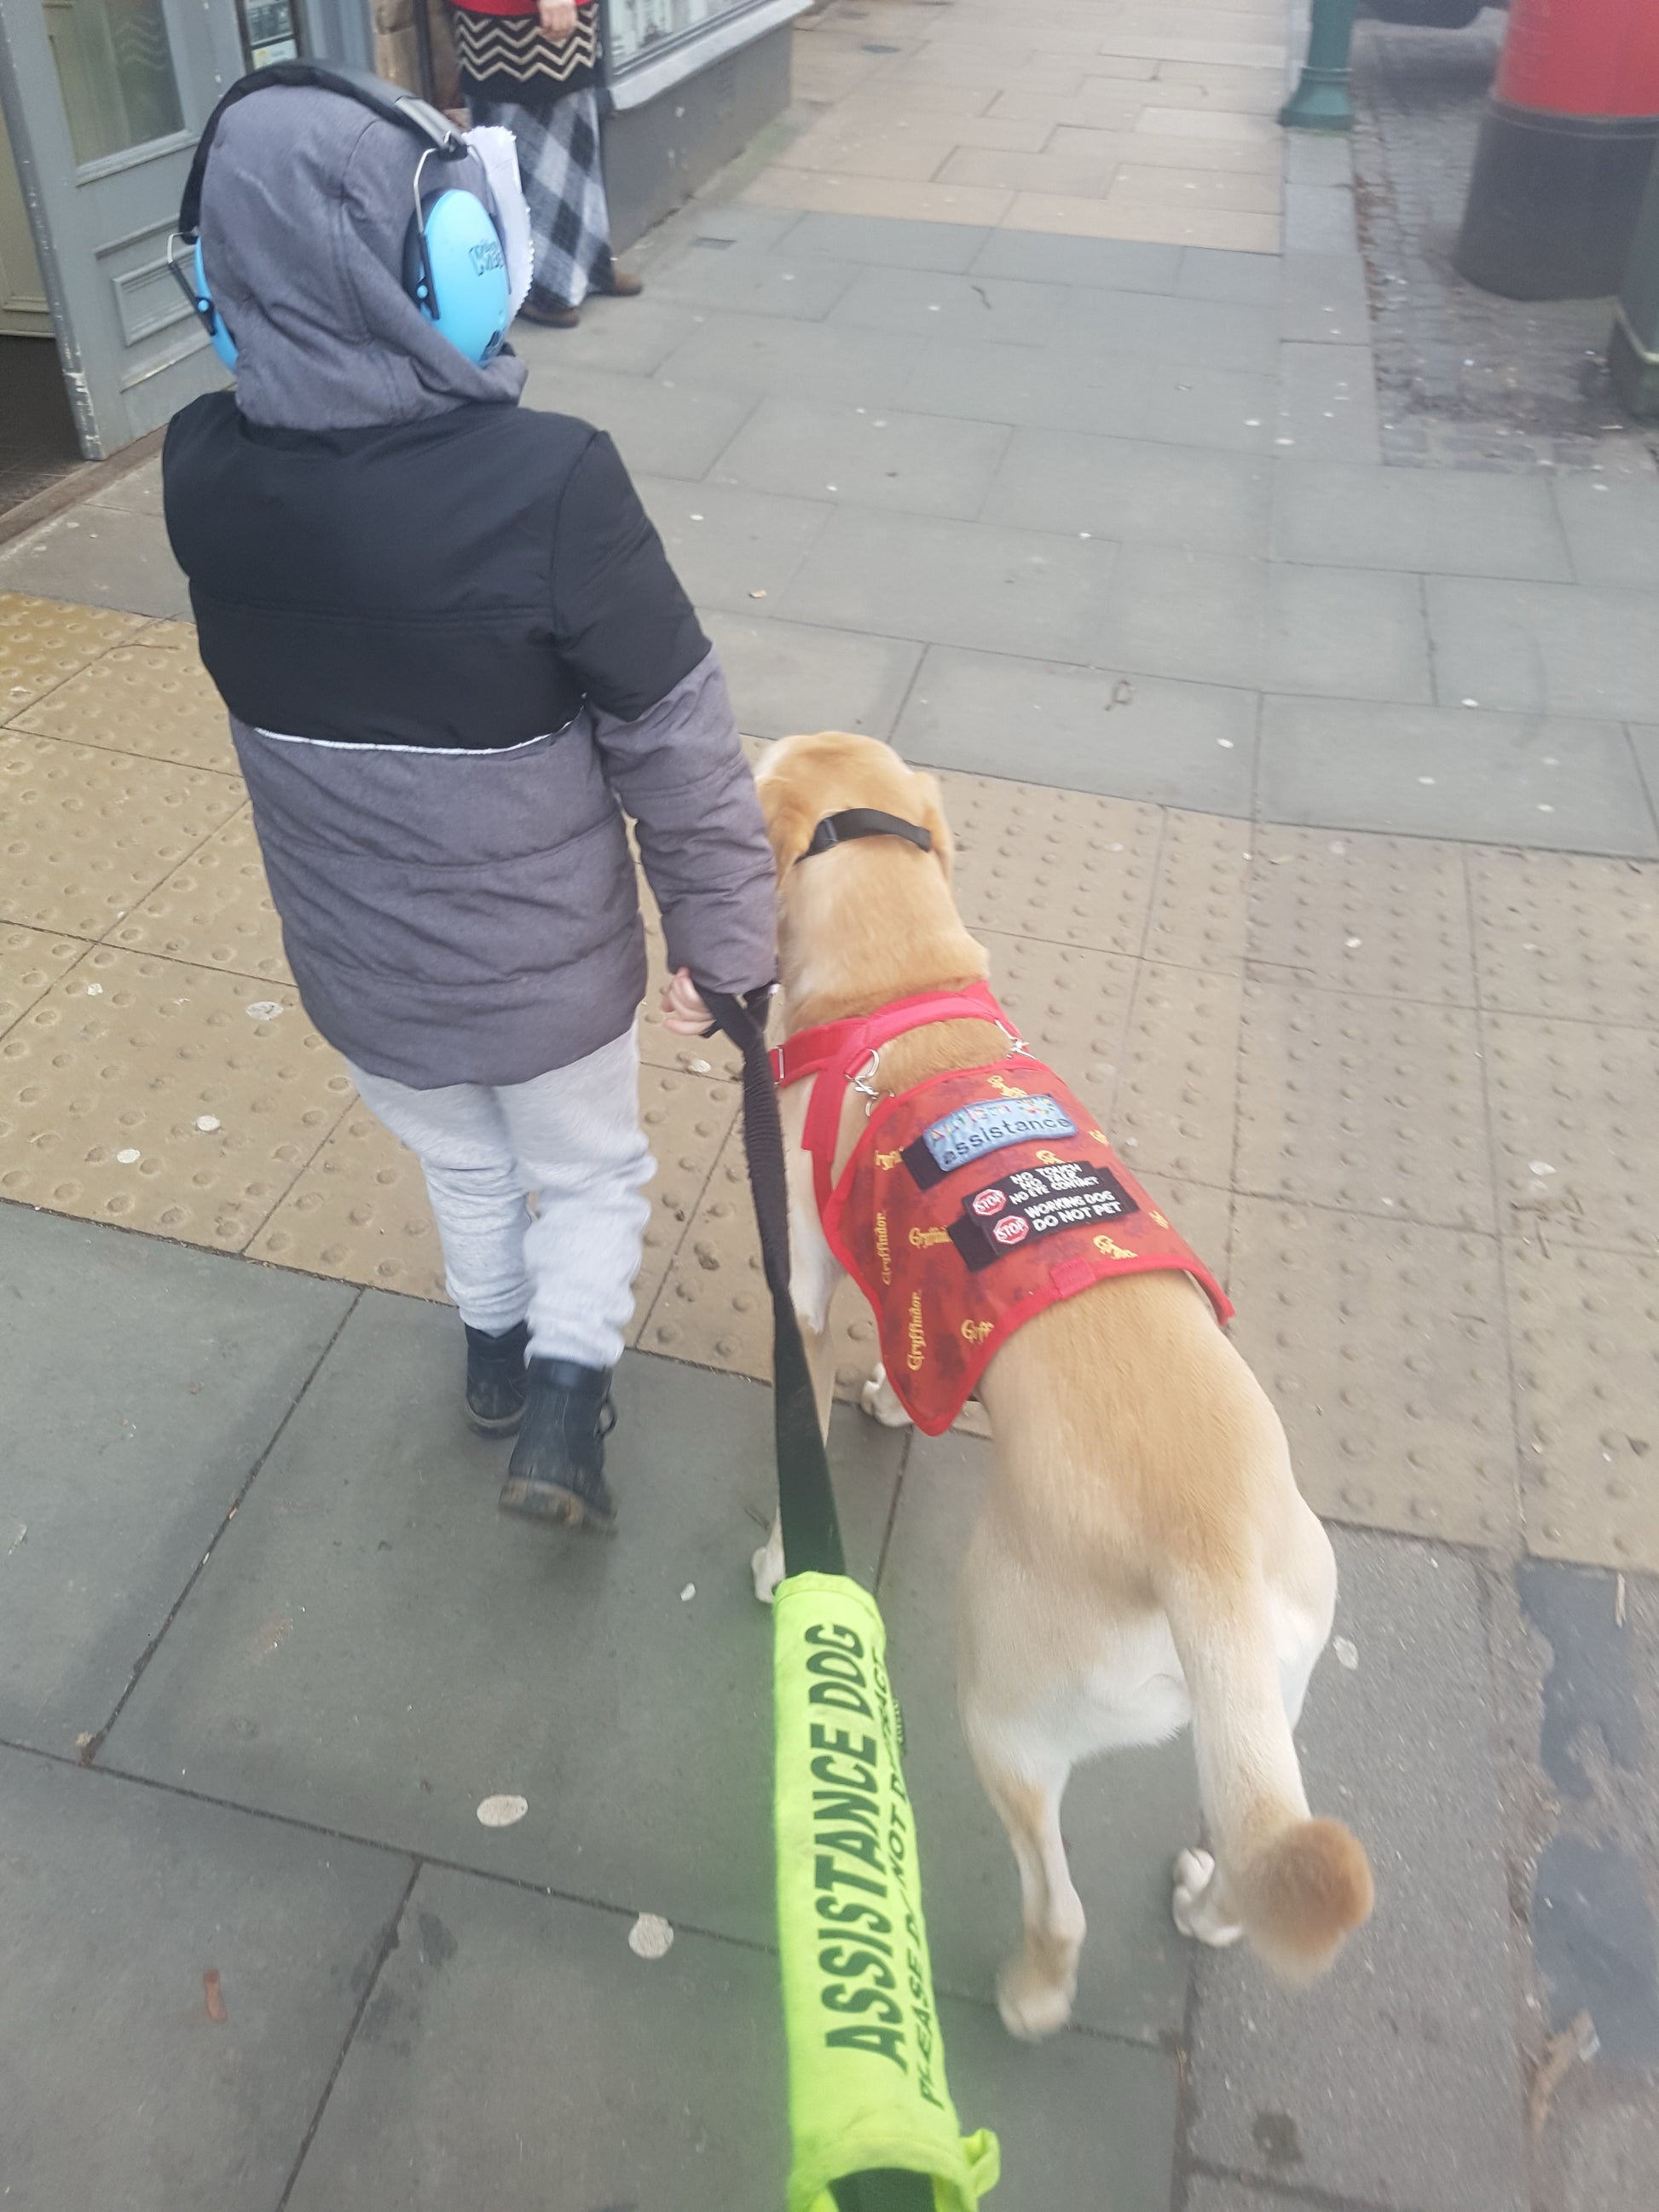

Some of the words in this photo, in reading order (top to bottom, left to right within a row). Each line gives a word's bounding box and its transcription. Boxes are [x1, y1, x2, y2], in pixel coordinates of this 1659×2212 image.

[942, 1116, 1072, 1165] assistance
[1009, 1171, 1033, 1185] NO
[1035, 1163, 1083, 1178] TOUCH
[1020, 1177, 1043, 1191] NO
[975, 1192, 1004, 1212] STOP
[1009, 1191, 1030, 1205] NO
[1027, 1184, 1050, 1198] EYE
[1050, 1176, 1100, 1191] CONTACT
[1024, 1195, 1086, 1219] WORKING
[1084, 1190, 1116, 1204] DOG
[996, 1218, 1026, 1239] STOP
[1032, 1215, 1059, 1232] DO
[1058, 1206, 1092, 1223] NOT
[1092, 1200, 1122, 1216] PET
[874, 1211, 893, 1285] Gryffindor
[907, 1291, 927, 1372] Gryffindor
[888, 1802, 908, 1891] NOT
[809, 1721, 909, 2075] ASSISTANCE
